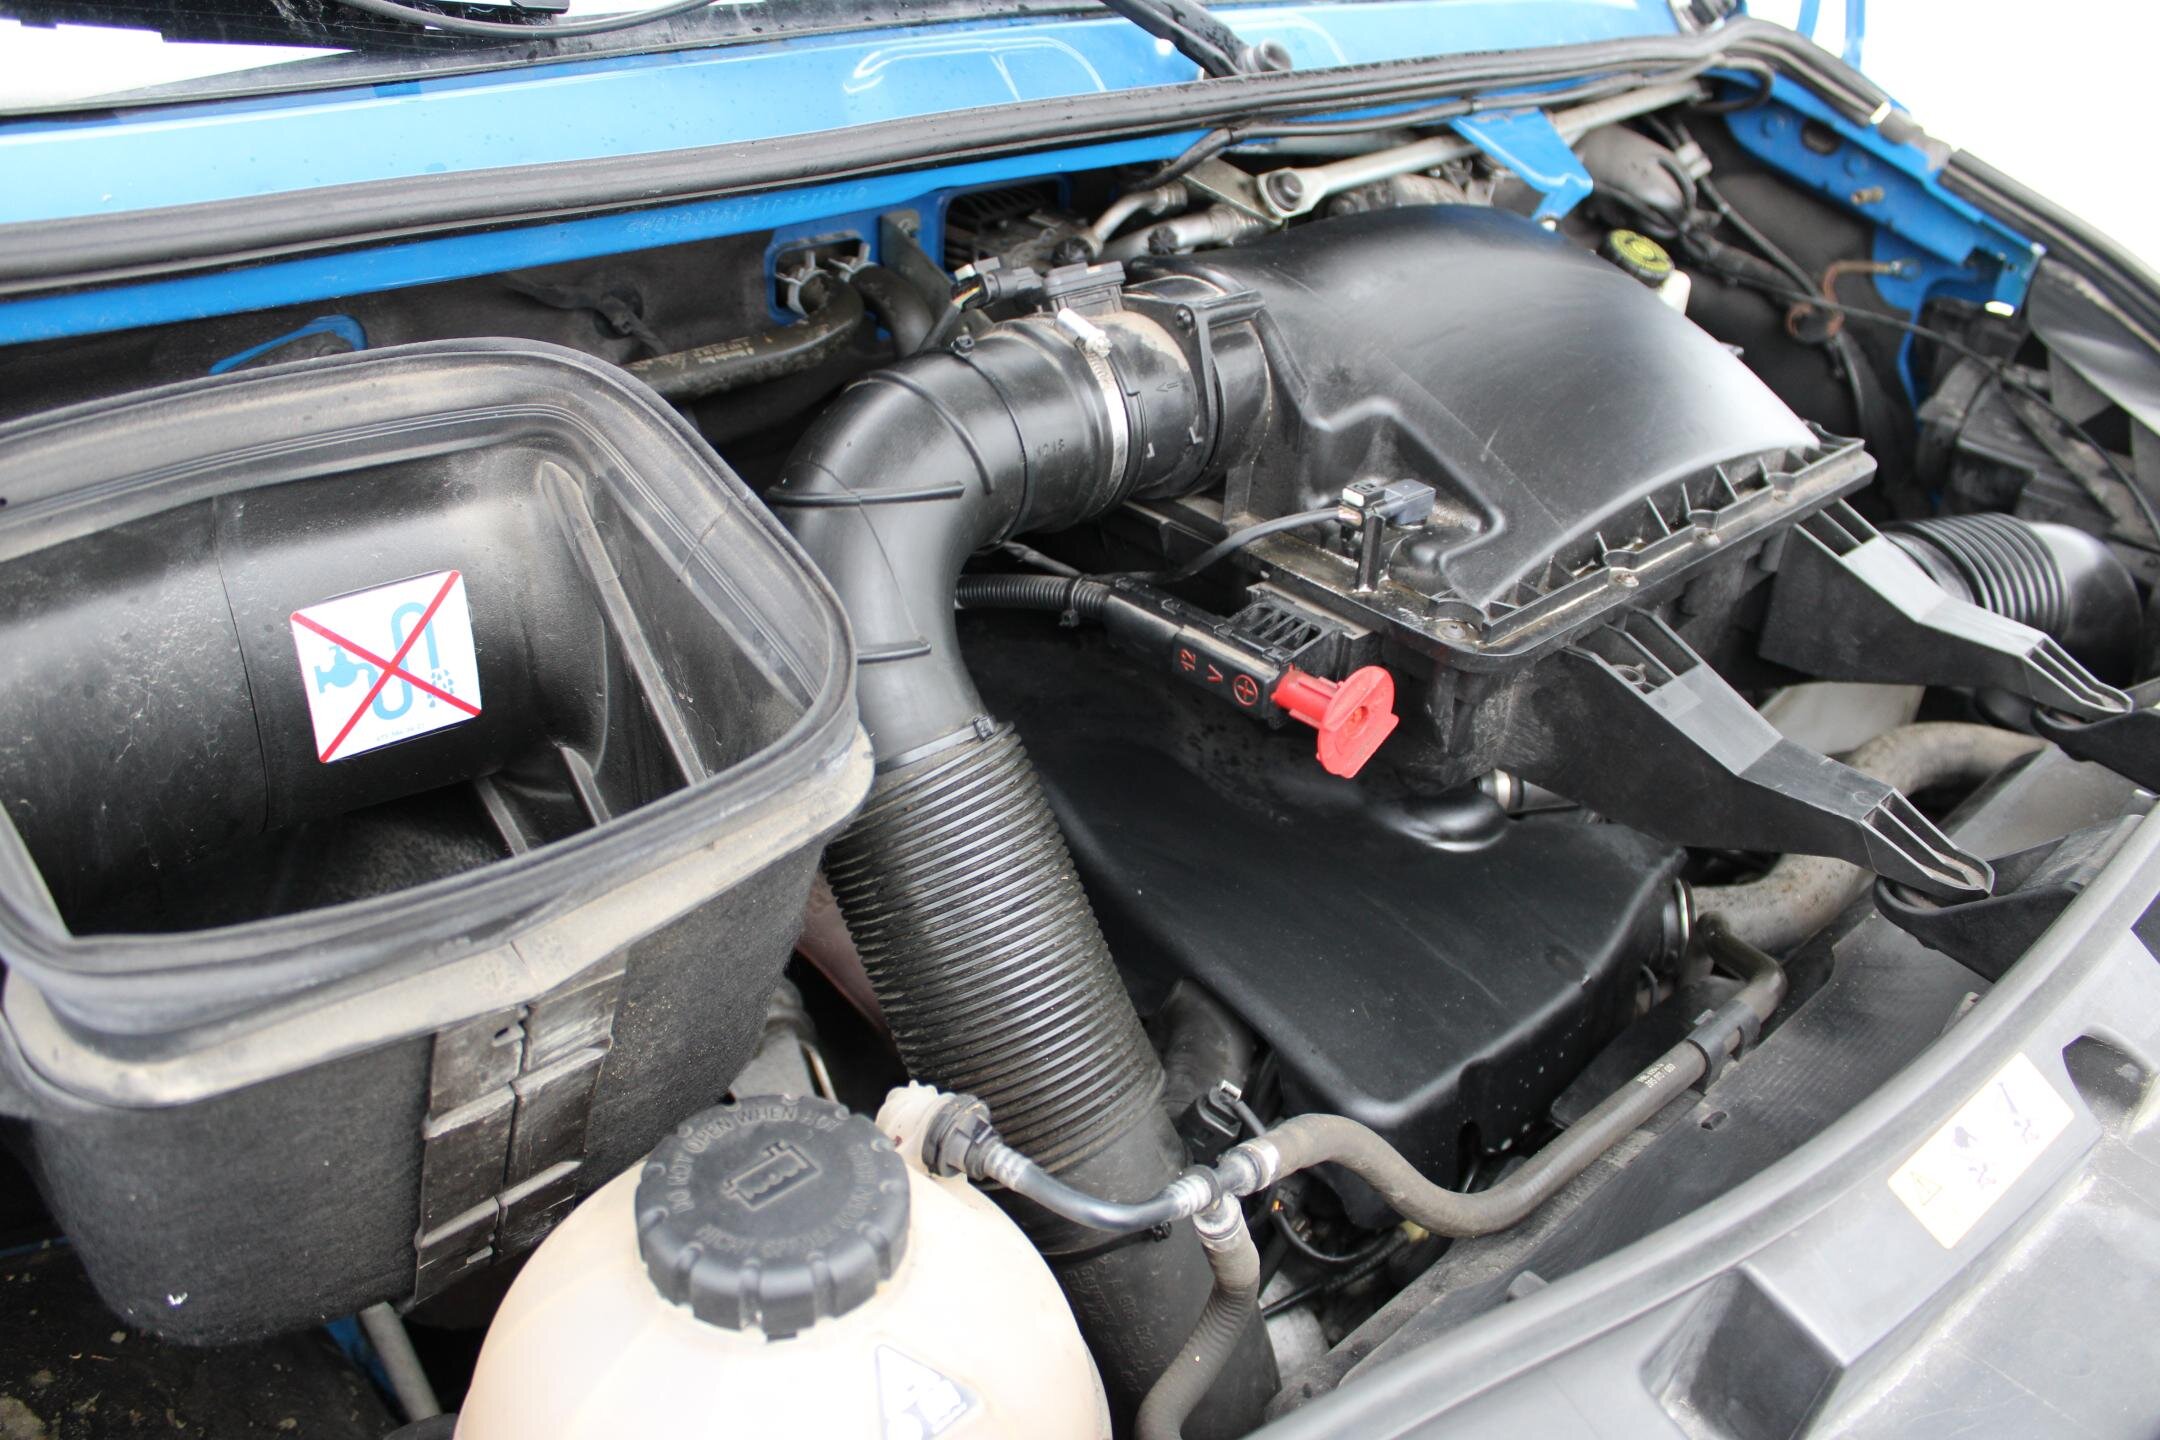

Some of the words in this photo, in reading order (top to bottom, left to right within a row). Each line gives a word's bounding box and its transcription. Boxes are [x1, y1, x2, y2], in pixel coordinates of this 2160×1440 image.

[1180, 648, 1196, 671] 12
[1207, 664, 1223, 682] V
[735, 1106, 799, 1126] WHEN
[802, 1110, 842, 1132] HOT
[685, 1116, 735, 1153] OPEN
[668, 1152, 693, 1186] NOT
[668, 1189, 694, 1213] DO
